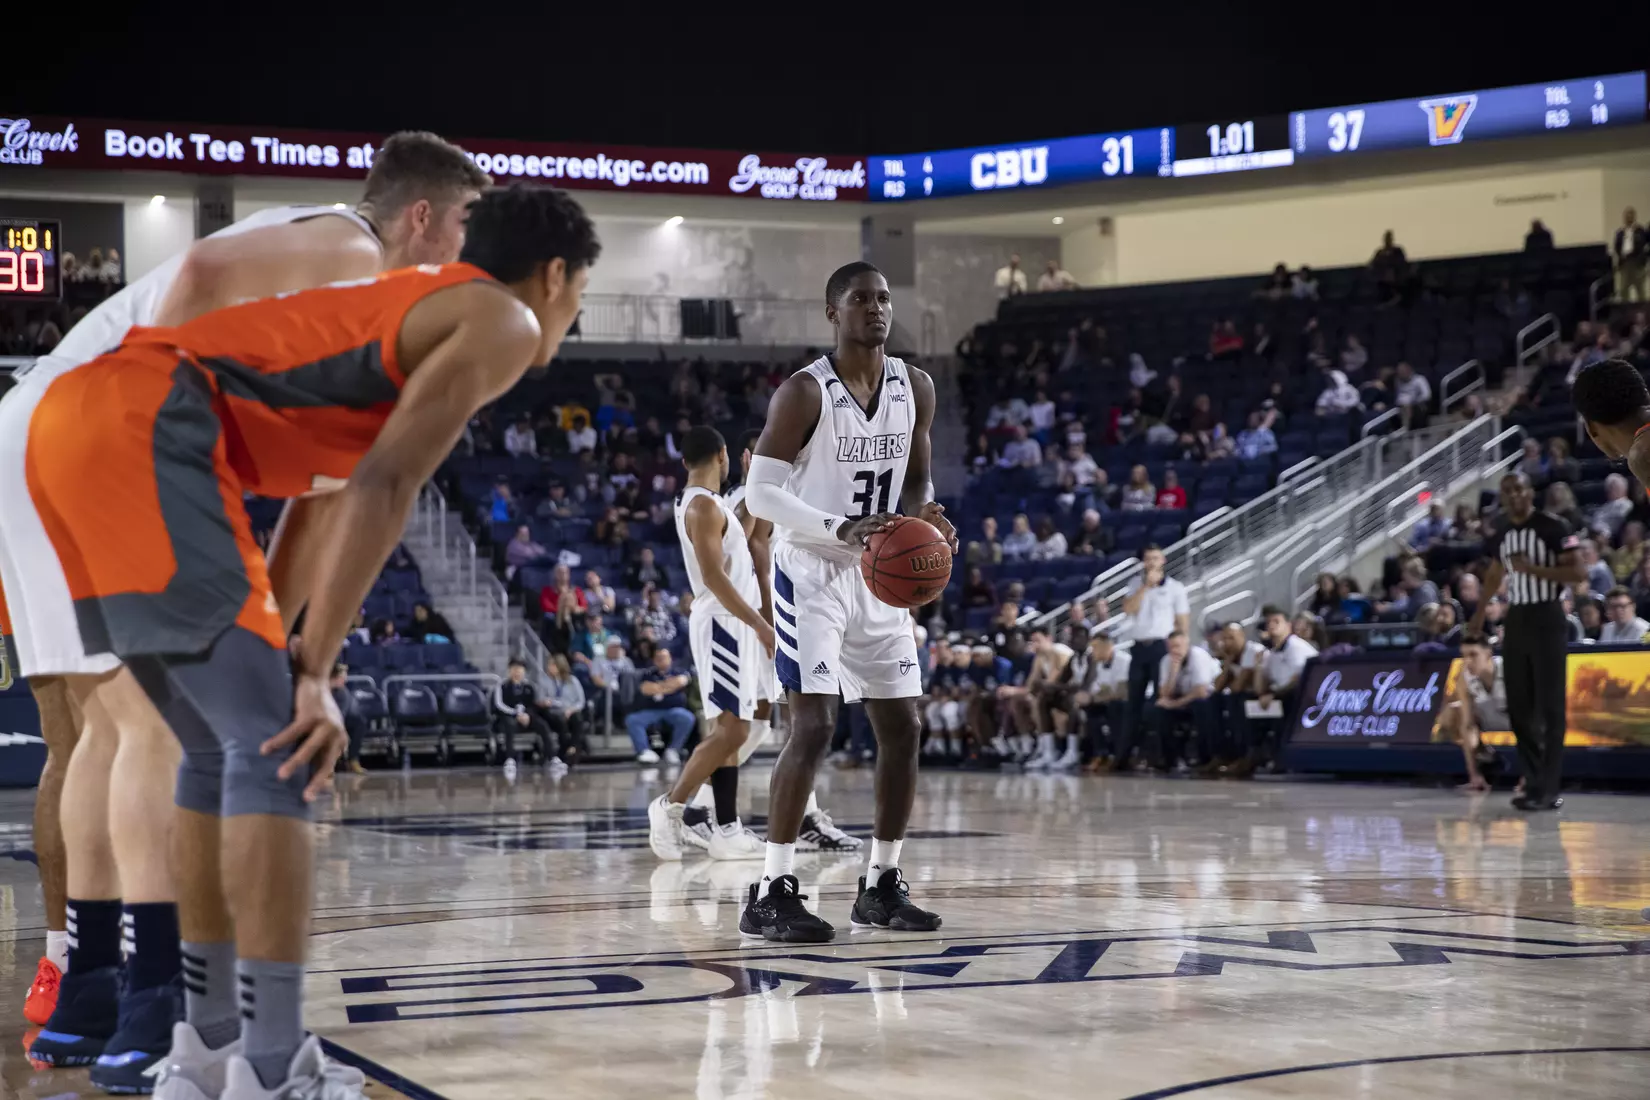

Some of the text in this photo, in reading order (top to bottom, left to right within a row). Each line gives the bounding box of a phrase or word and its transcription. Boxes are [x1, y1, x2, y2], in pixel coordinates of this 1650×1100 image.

[0, 118, 79, 152] Creek
[1207, 121, 1254, 156] 1:01
[1328, 110, 1365, 152] 37
[0, 147, 43, 165] CLUB
[104, 129, 709, 186] Book Tee Times at oosecreekgc.com
[970, 146, 1049, 190] CBU
[1102, 135, 1133, 176] 31
[729, 154, 866, 193] Goose Creek
[799, 183, 837, 200] CLUB
[8, 227, 52, 251] 1:01
[890, 394, 905, 402] WAC
[845, 468, 893, 521] 31
[909, 552, 952, 573] Wilso
[1301, 669, 1439, 728] Goose Creek
[1327, 715, 1400, 736] GOLF CLUB
